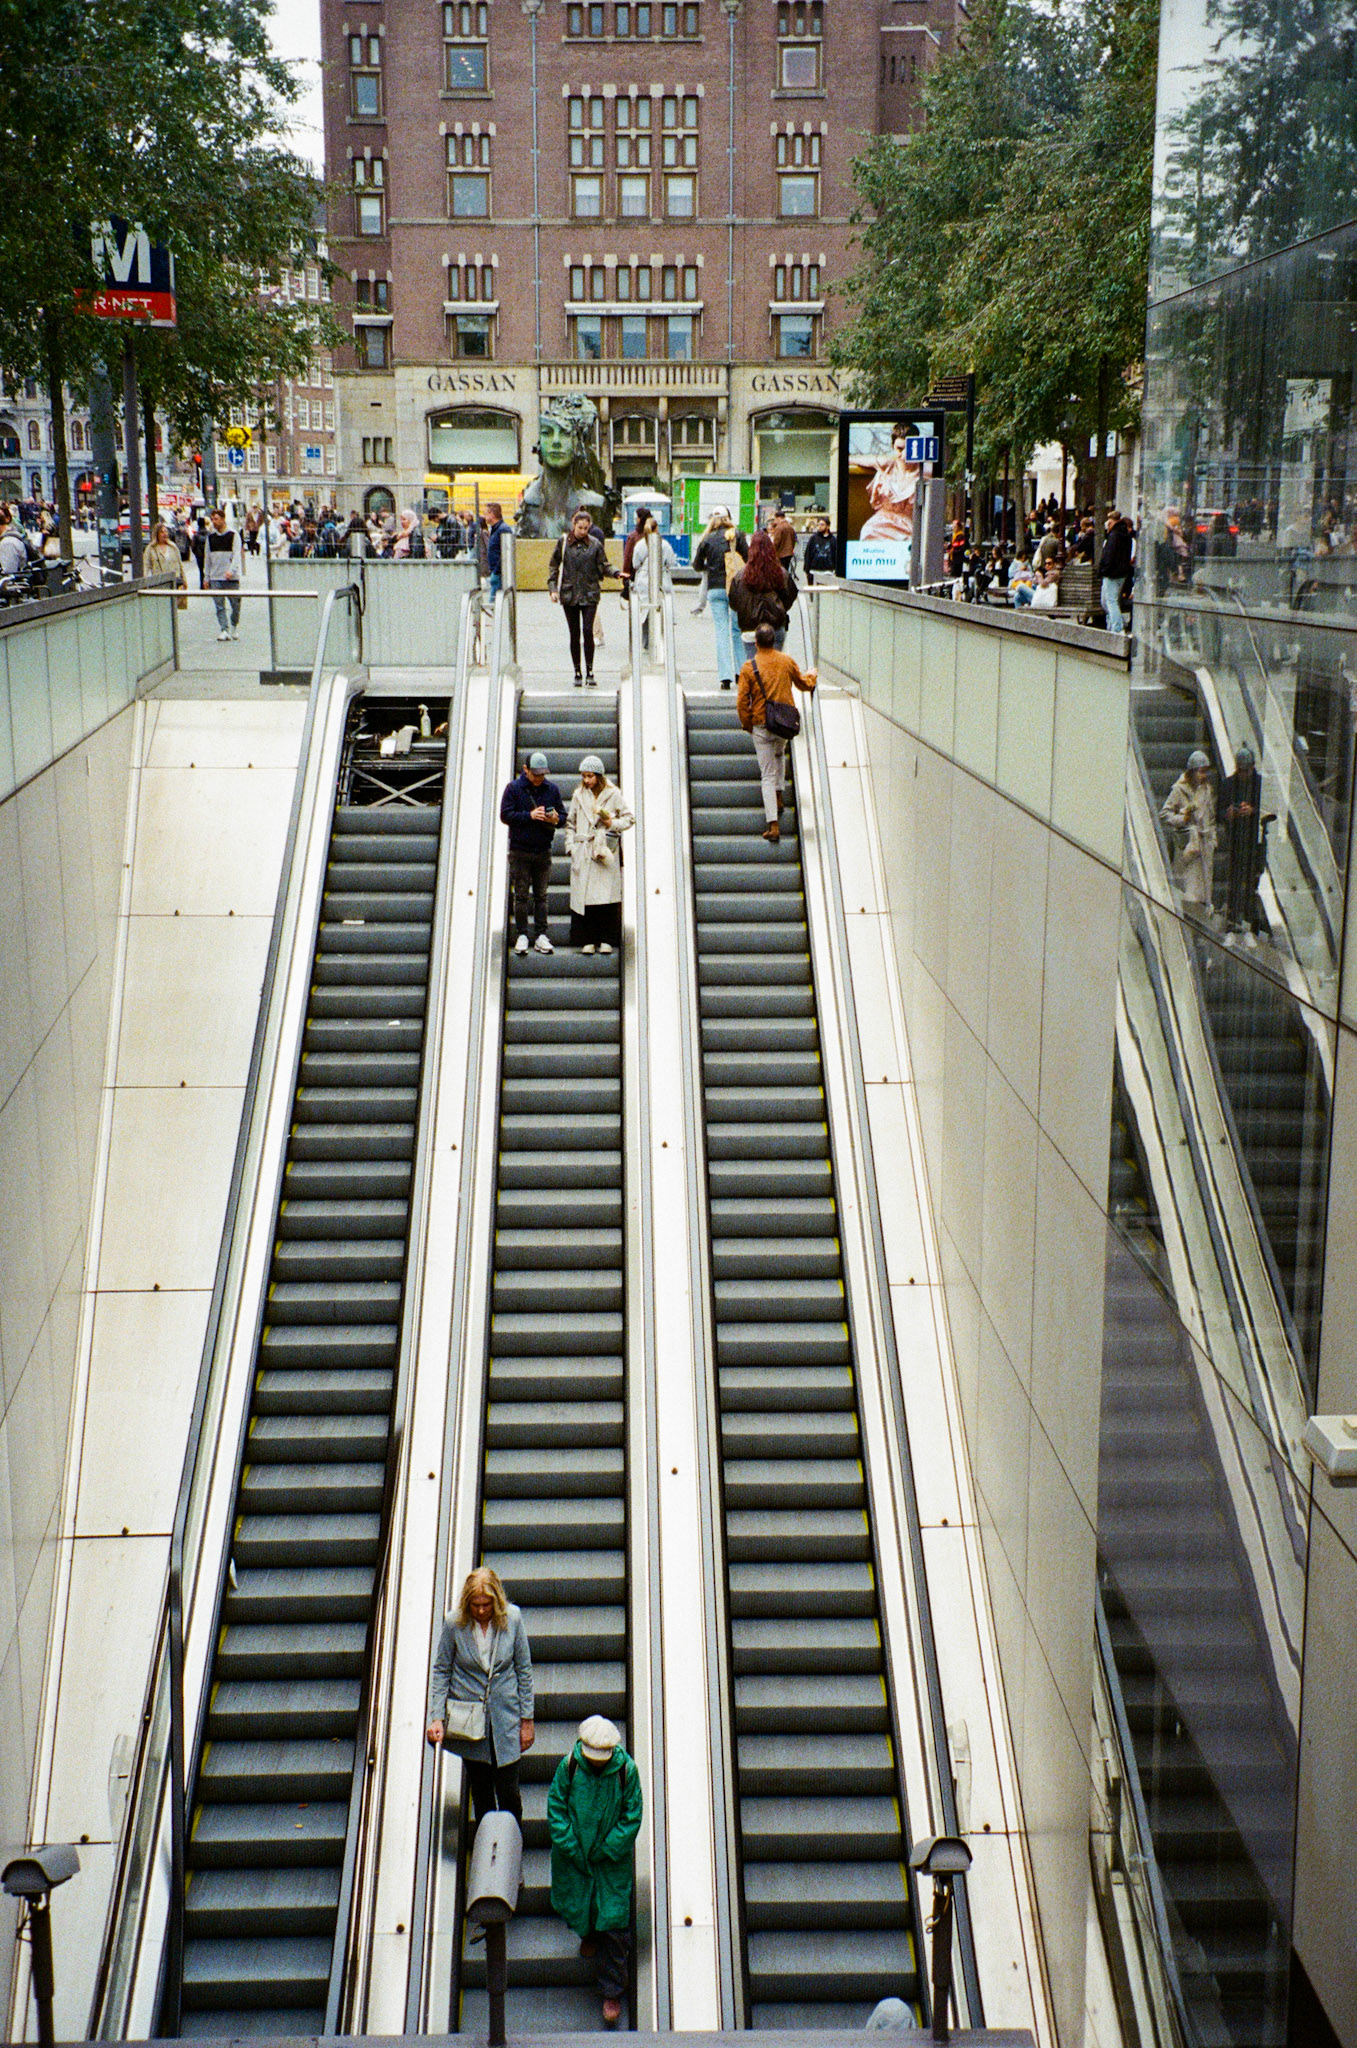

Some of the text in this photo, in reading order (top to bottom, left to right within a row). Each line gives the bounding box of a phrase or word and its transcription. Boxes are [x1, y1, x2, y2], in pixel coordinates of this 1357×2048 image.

[90, 220, 152, 284] M
[427, 374, 517, 391] GASSAN
[752, 374, 841, 391] GASSAN
